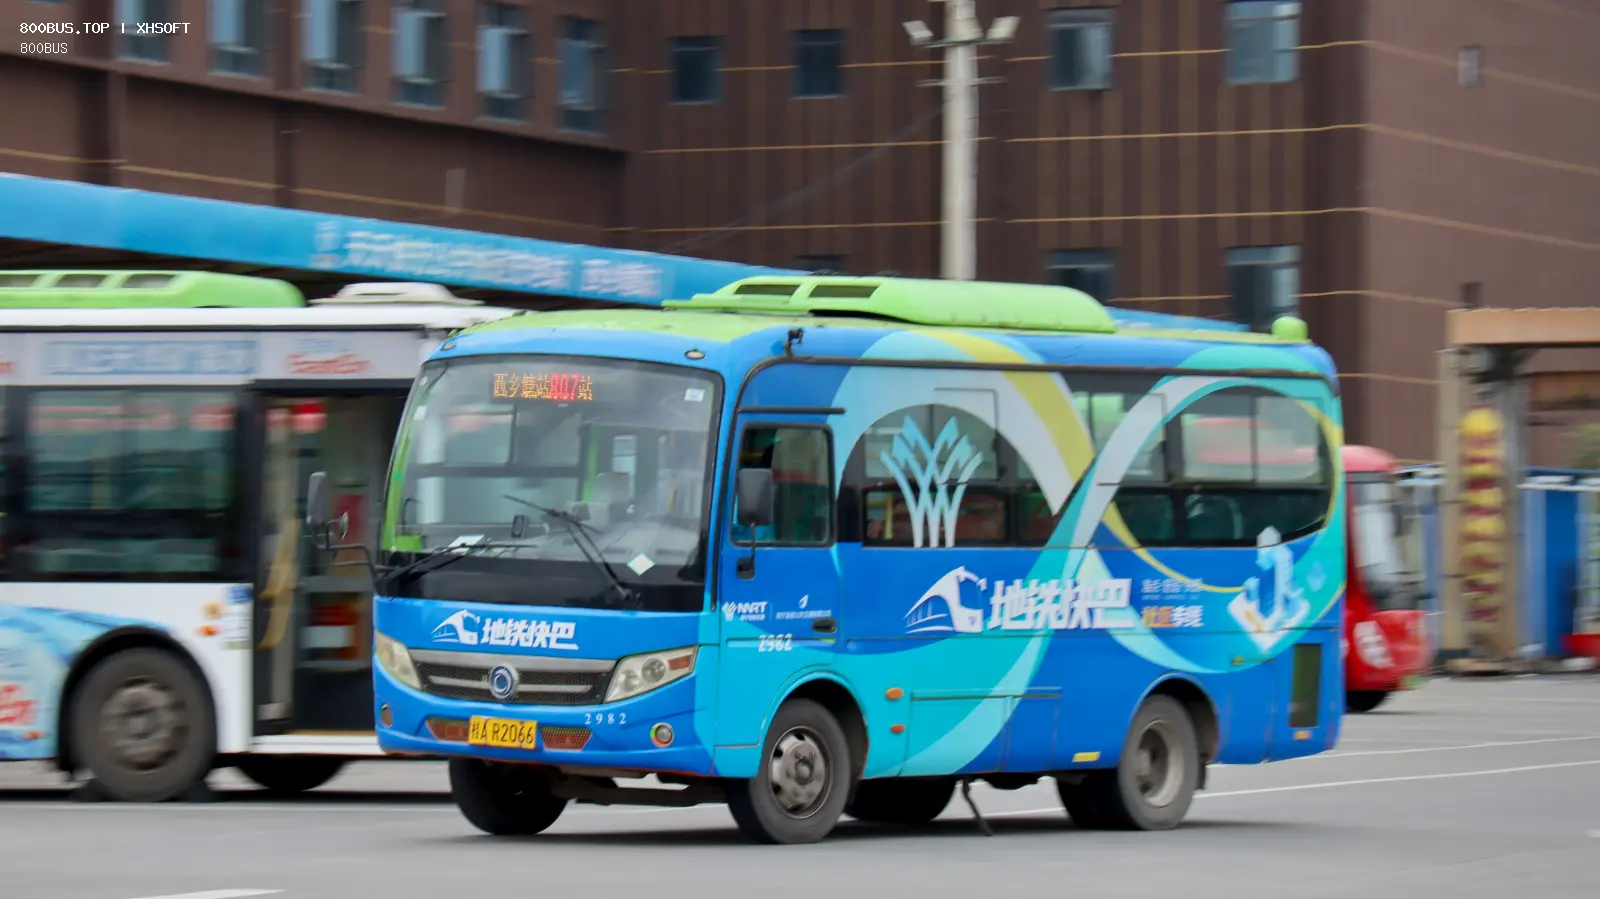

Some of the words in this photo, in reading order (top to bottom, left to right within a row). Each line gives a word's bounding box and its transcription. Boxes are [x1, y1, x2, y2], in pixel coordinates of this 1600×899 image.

[990, 578, 1136, 630] 地铁快巴
[480, 617, 580, 651] 地铁快巴
[584, 712, 627, 725] 2982
